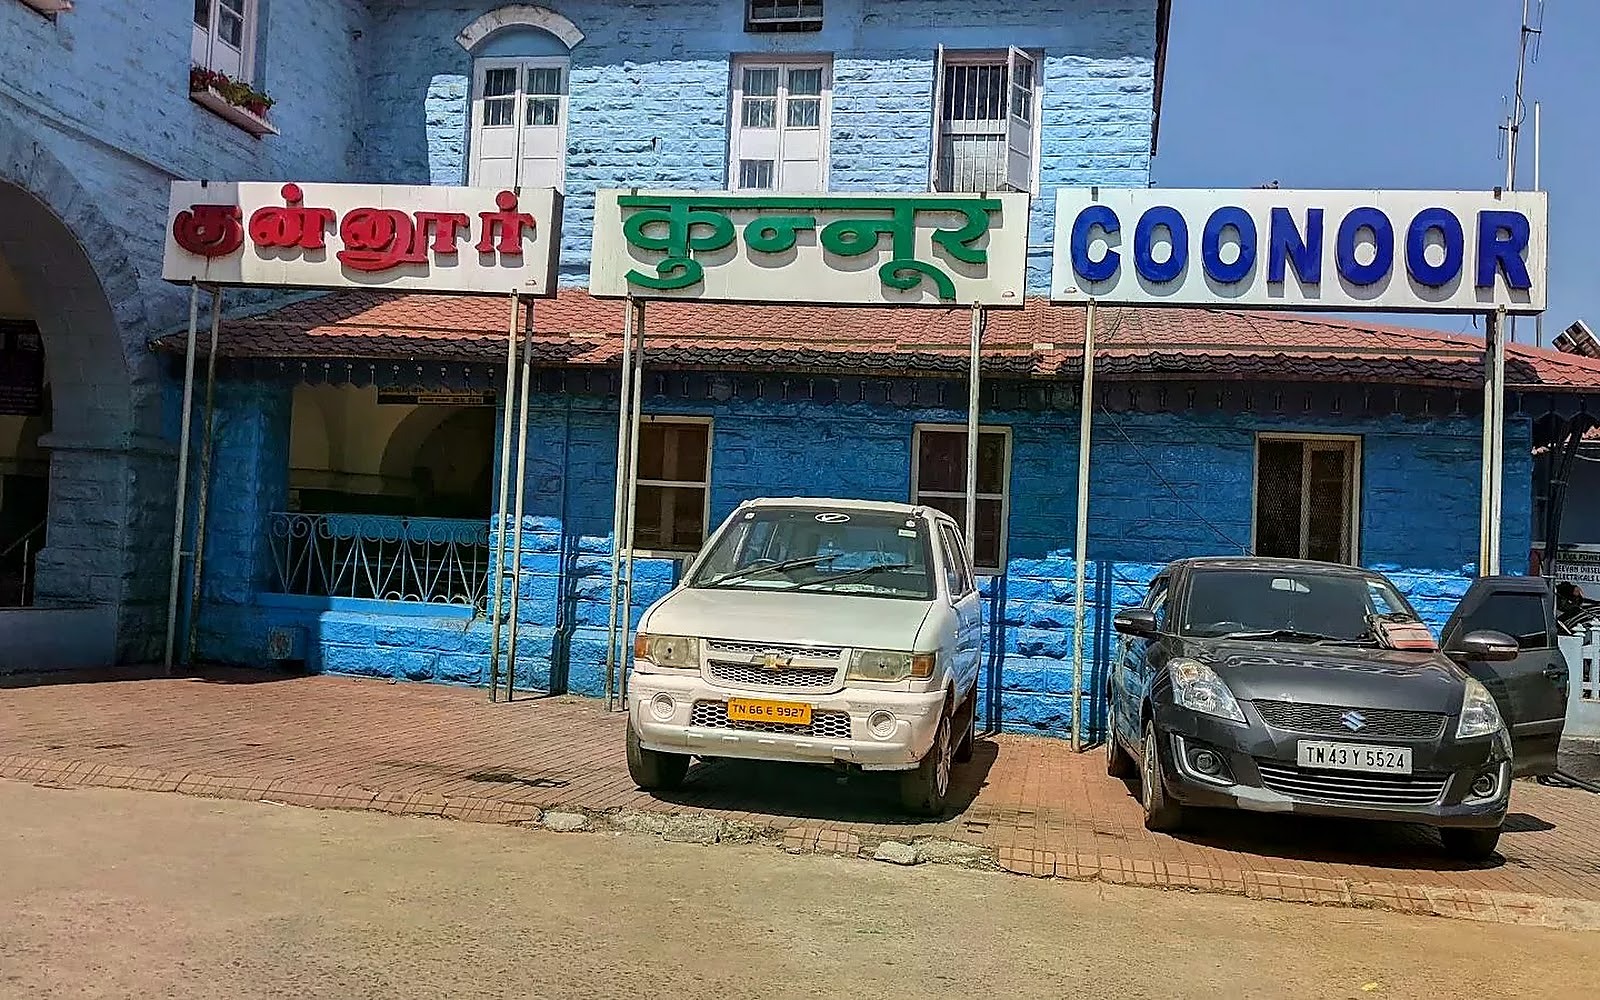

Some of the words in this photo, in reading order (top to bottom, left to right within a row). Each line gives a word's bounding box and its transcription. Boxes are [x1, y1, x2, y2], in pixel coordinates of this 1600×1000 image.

[173, 183, 537, 274] குன்னூர்
[617, 195, 1003, 303] कुन्नूर
[1071, 205, 1532, 290] COONOOR
[733, 704, 746, 714] TN
[749, 705, 763, 714] 66
[766, 706, 773, 716] E
[776, 707, 804, 717] 9927
[1366, 751, 1404, 768] 5524
